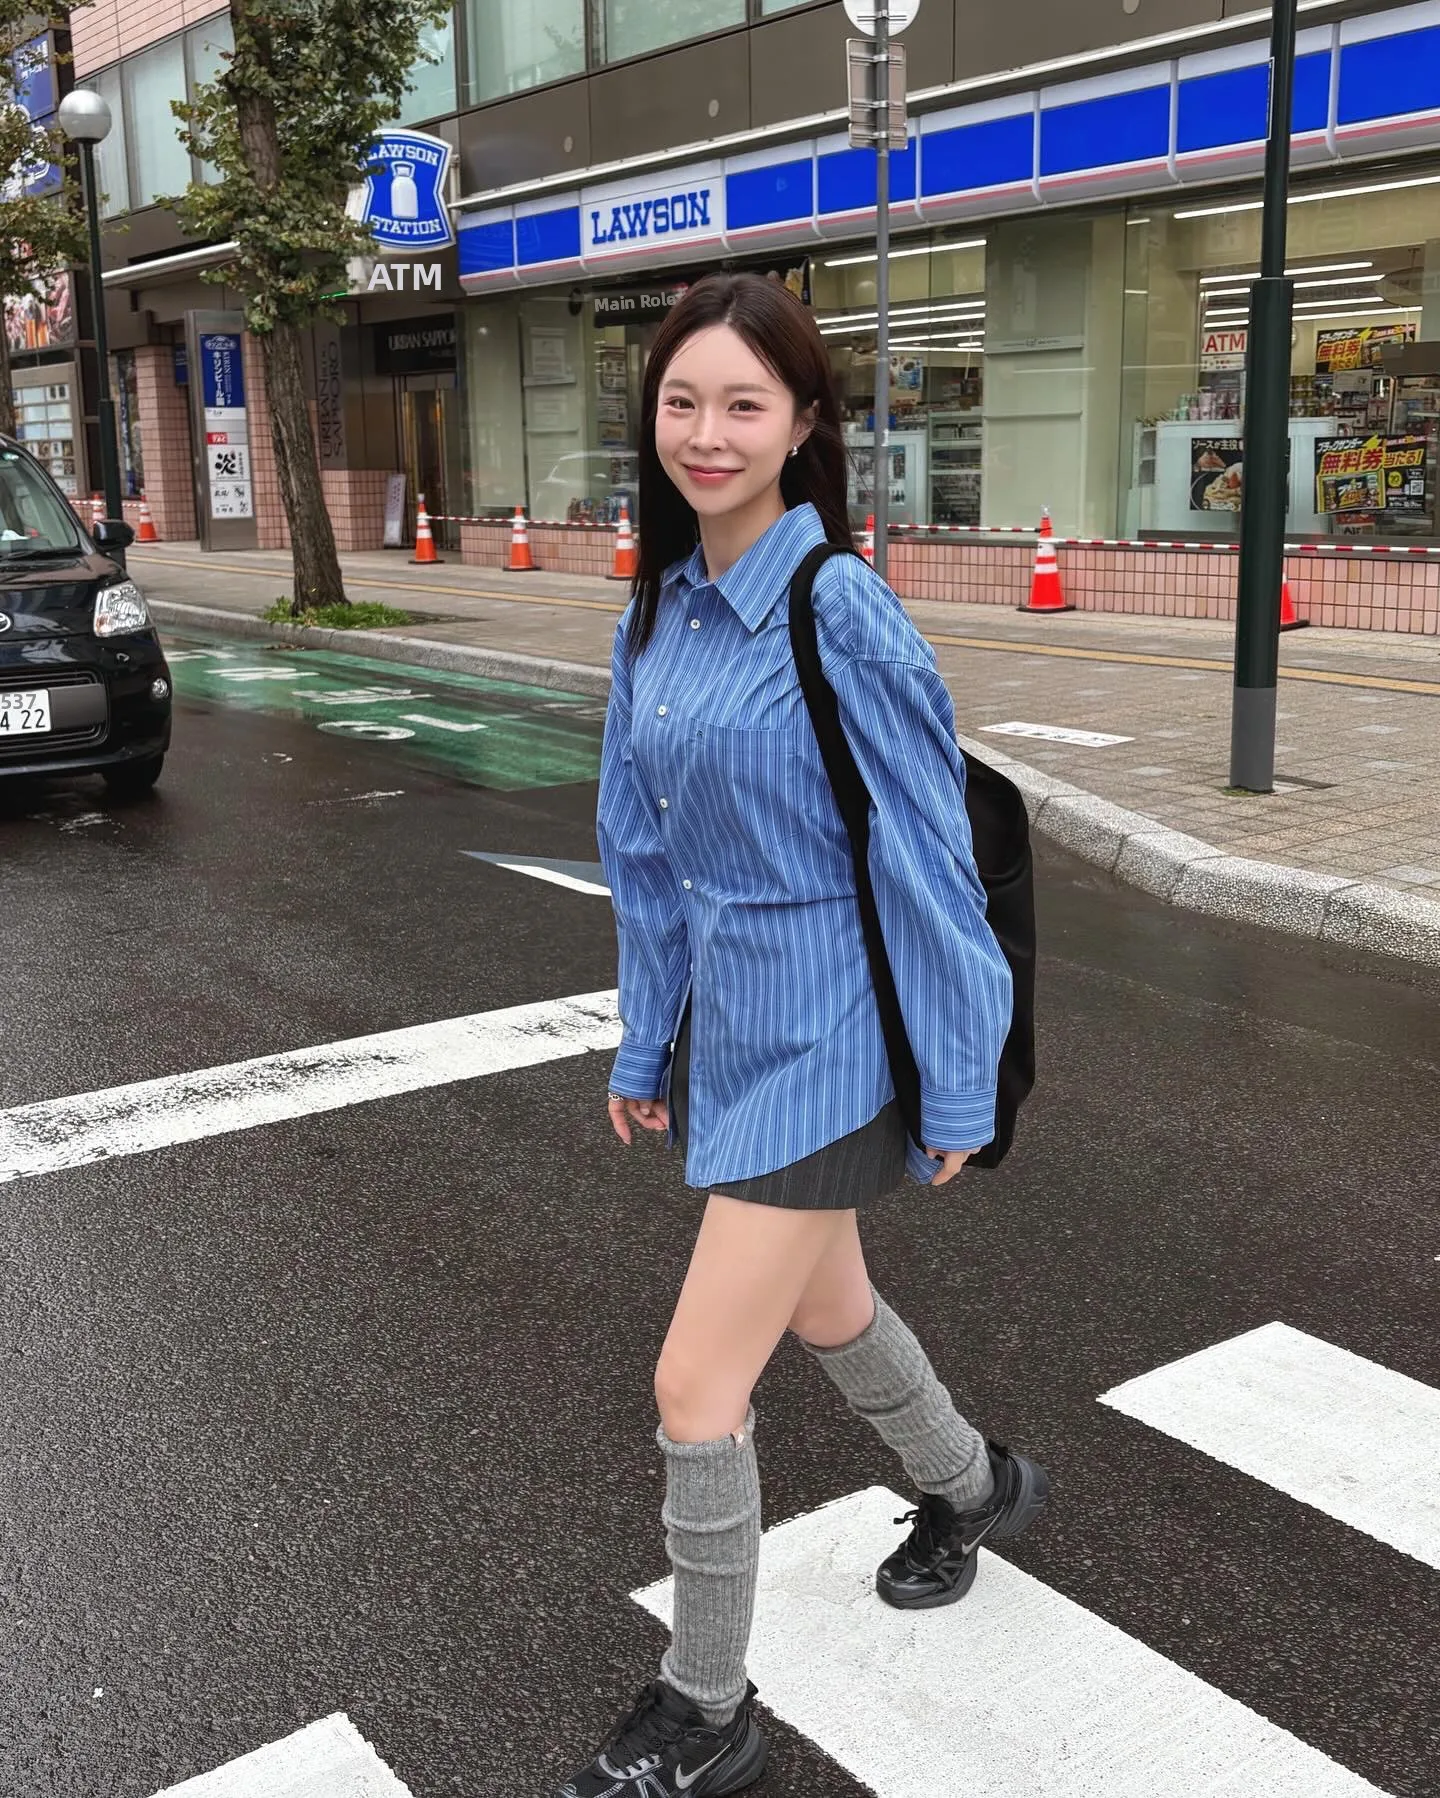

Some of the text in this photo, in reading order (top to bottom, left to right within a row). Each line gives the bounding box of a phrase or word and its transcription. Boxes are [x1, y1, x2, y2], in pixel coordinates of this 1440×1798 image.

[368, 143, 439, 166] LAWSON
[369, 214, 442, 236] STATION
[591, 189, 710, 245] LAWSON
[367, 263, 442, 291] ATM
[594, 295, 635, 313] Main
[1205, 332, 1245, 353] ATM
[1318, 339, 1361, 361] 無料券
[1321, 447, 1383, 475] 無料券
[1, 693, 37, 710] 537
[21, 708, 46, 730] 22
